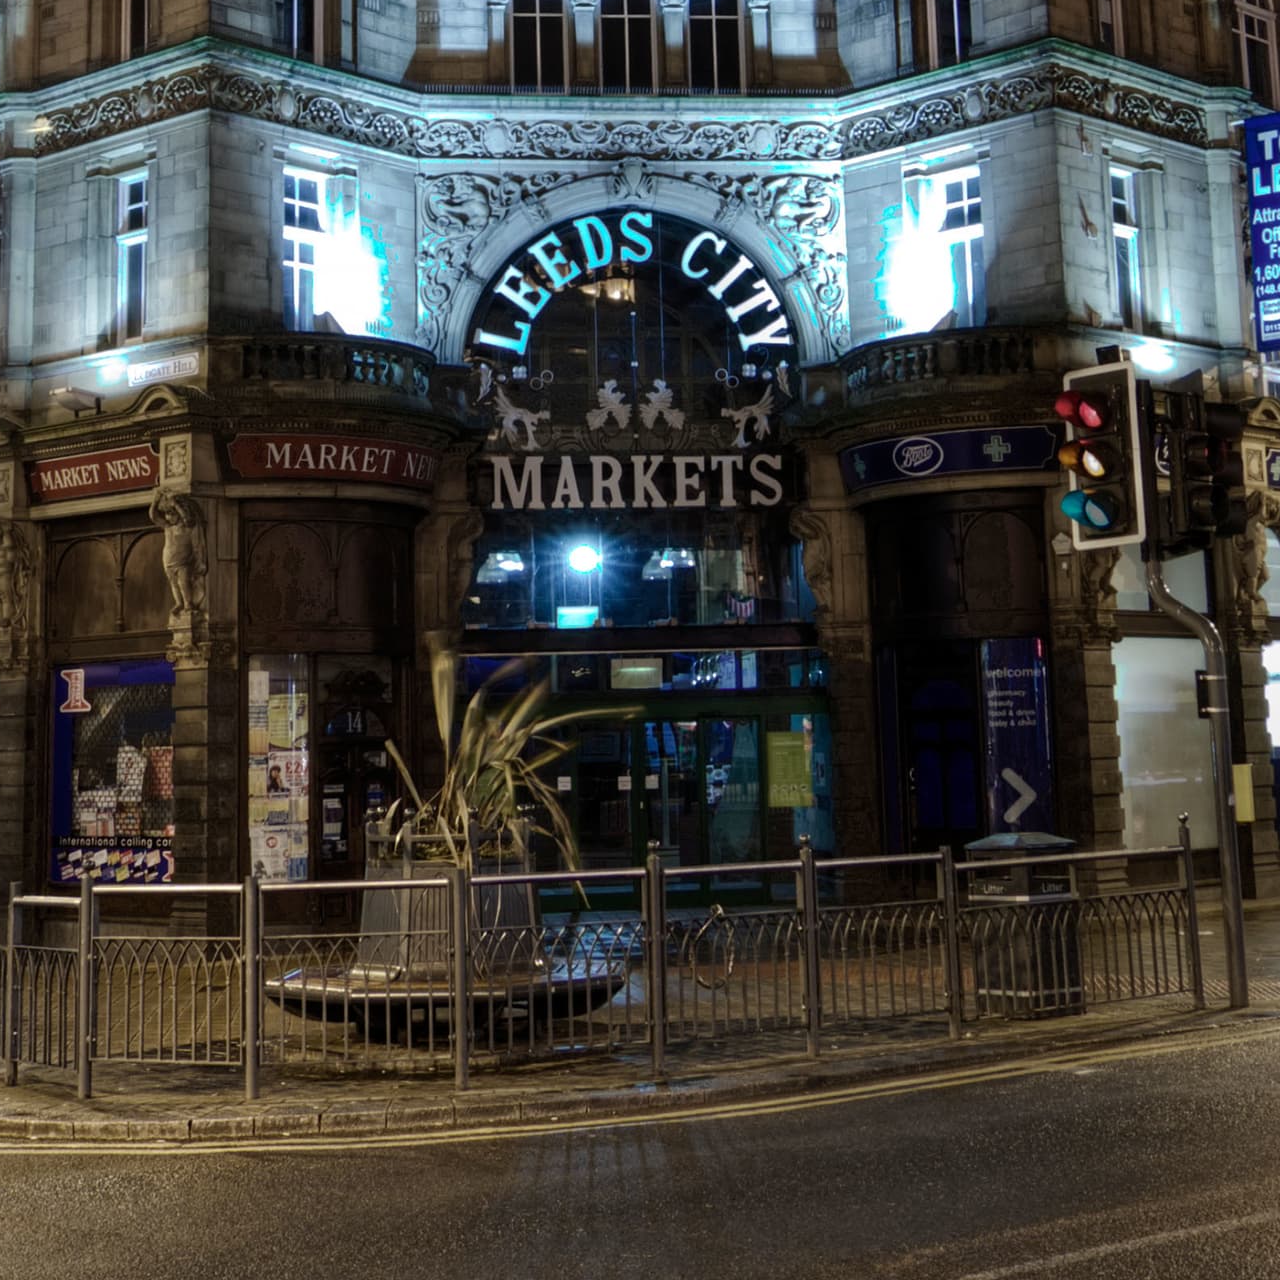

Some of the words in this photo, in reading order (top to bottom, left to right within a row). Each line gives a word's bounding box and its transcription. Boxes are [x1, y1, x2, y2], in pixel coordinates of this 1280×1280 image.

[473, 211, 653, 355] LEEDS
[681, 231, 794, 352] CITY
[40, 464, 100, 492] MARKET
[107, 456, 152, 482] NEWS
[265, 442, 396, 474] MARKET
[490, 453, 783, 510] MARKETS
[985, 666, 1042, 678] welcome
[346, 711, 363, 734] 14
[59, 837, 118, 847] international
[121, 837, 153, 849] calling
